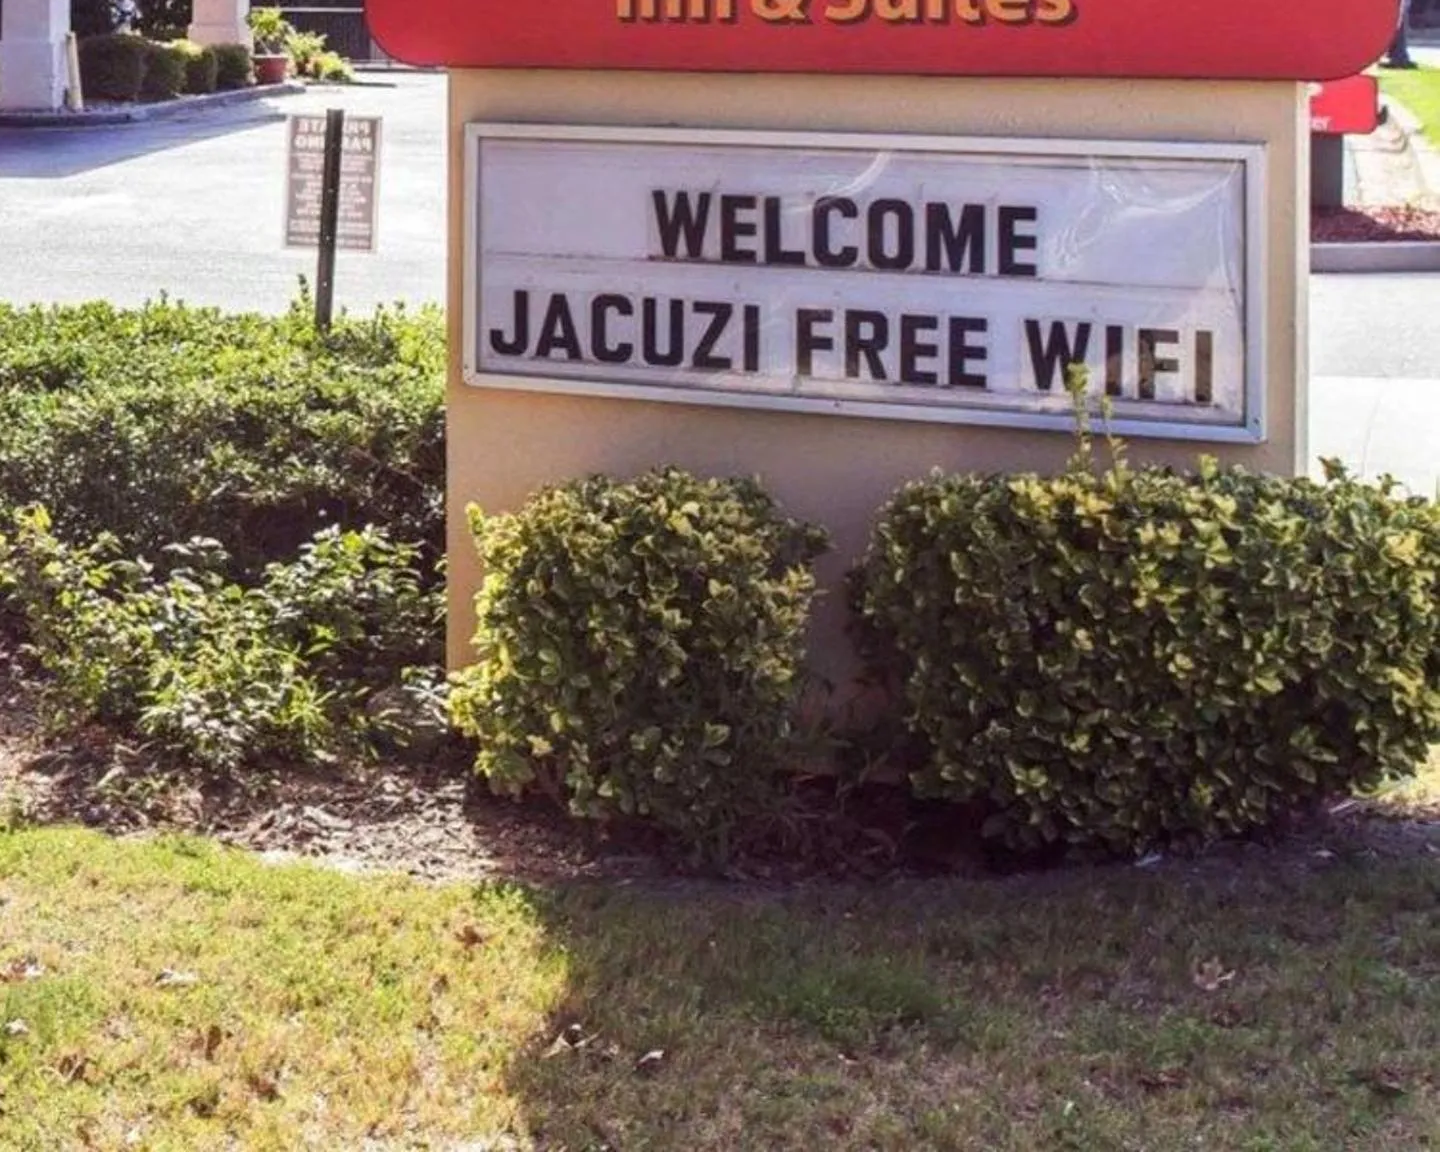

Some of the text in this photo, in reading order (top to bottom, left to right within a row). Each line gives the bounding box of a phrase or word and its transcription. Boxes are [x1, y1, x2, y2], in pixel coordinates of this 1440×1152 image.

[651, 189, 1038, 276] WELCOME
[489, 289, 1213, 403] JACUZI FREE WIFI
